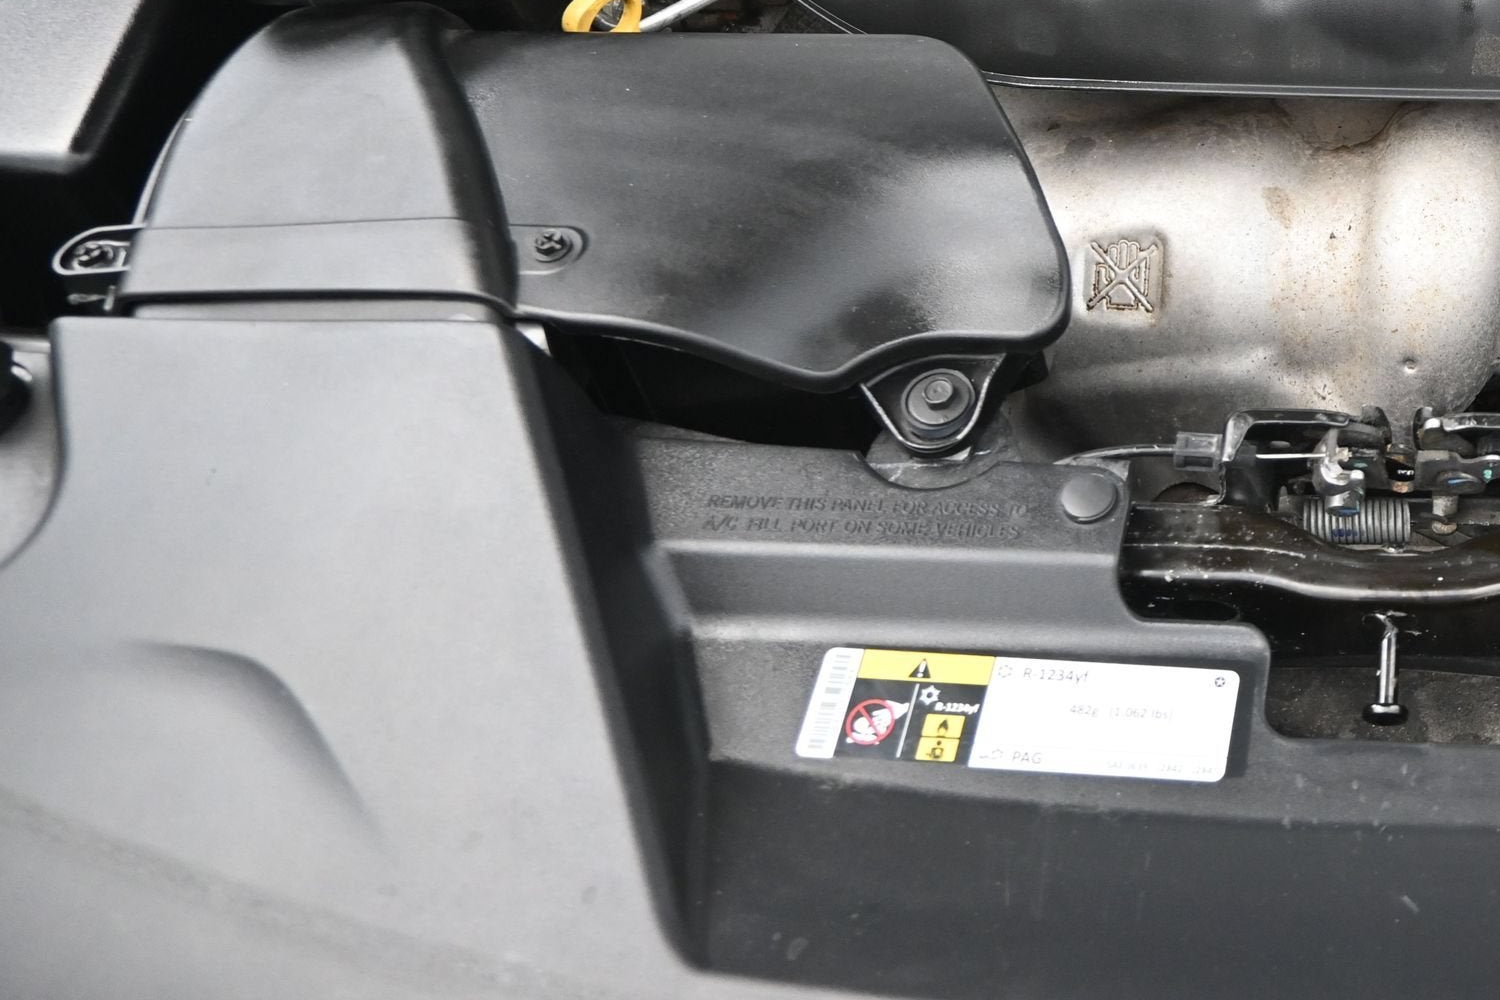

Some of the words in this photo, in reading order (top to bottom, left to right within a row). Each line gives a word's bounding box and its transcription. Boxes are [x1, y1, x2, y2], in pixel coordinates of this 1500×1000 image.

[708, 494, 783, 510] REMOVE
[787, 497, 827, 511] THIS
[831, 498, 885, 513] PANEL
[893, 500, 928, 514] FOR
[932, 501, 1000, 516] ACCESS
[1009, 503, 1029, 516] TO
[702, 514, 739, 531] A/C
[747, 516, 782, 532] FILL
[790, 518, 835, 533] PORT
[844, 519, 873, 534] ON
[876, 520, 928, 536] SOME
[936, 521, 1021, 539] VEHICLES
[1023, 667, 1089, 683] R-1234yf
[934, 701, 981, 716] R-1234yf
[1069, 703, 1100, 718] 482g
[1011, 749, 1043, 764] PAG
